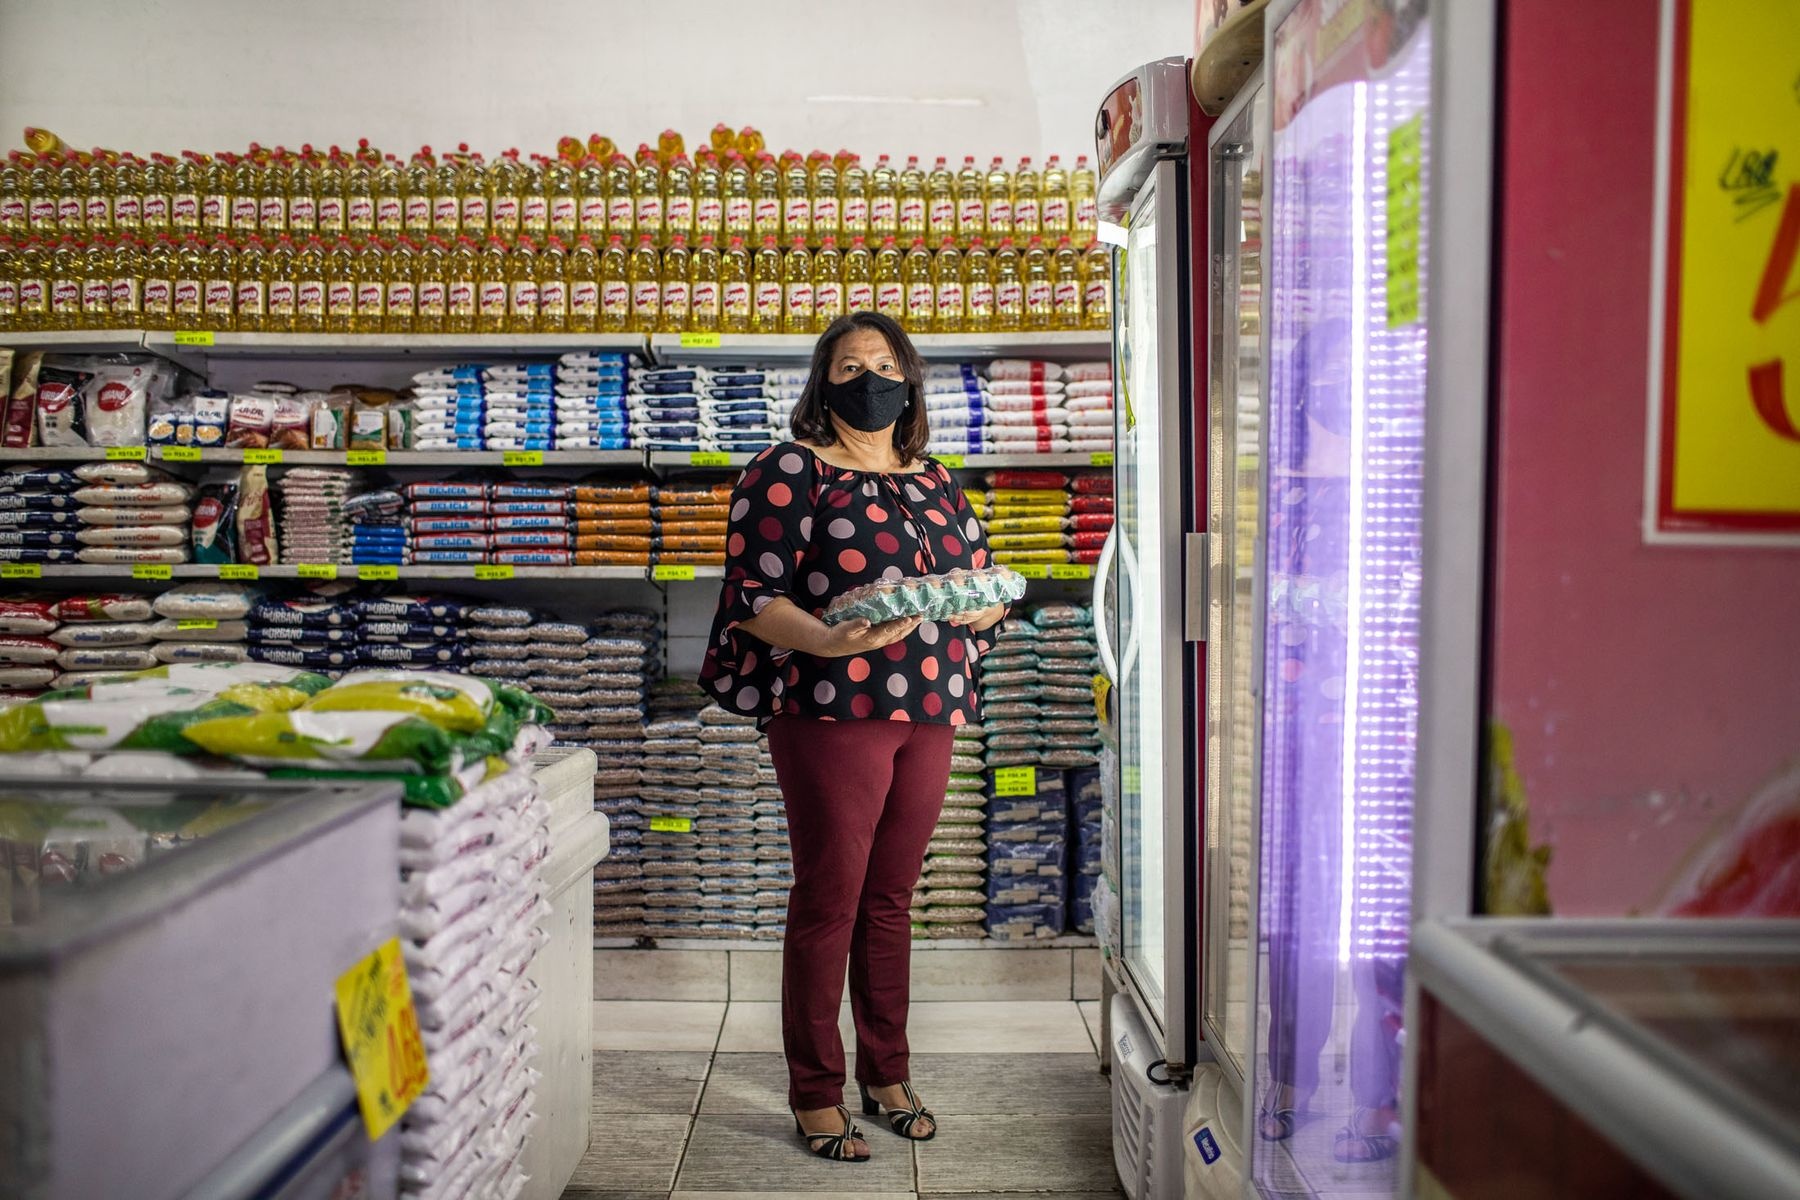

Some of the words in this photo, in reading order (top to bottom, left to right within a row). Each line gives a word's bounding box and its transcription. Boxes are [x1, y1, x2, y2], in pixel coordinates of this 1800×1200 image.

[55, 289, 77, 300] Soya
[85, 289, 108, 300] Soya
[145, 290, 166, 300] Soya
[208, 289, 229, 301] Soya
[271, 290, 290, 301] Soya
[301, 290, 319, 301] Soya
[330, 290, 350, 301] Soya
[390, 291, 411, 302] Soya
[421, 291, 440, 302] Soya
[482, 291, 503, 302] Soya
[517, 291, 538, 302] Soya
[574, 291, 595, 302] Soya
[605, 291, 626, 302] Soya
[637, 291, 657, 302] Soya
[664, 291, 685, 302] Soya
[694, 291, 713, 302] Soya
[0, 473, 24, 487] RBANO
[0, 497, 26, 509] RBANO
[0, 512, 26, 523] RBANO
[0, 532, 23, 544] BANO
[0, 549, 21, 560] BANO
[373, 602, 408, 615] URBANO
[270, 610, 303, 624] URBANO
[269, 628, 303, 640] URBANO
[374, 622, 409, 635] URBANO
[270, 650, 304, 664] URBANO
[378, 648, 412, 661] URBANO
